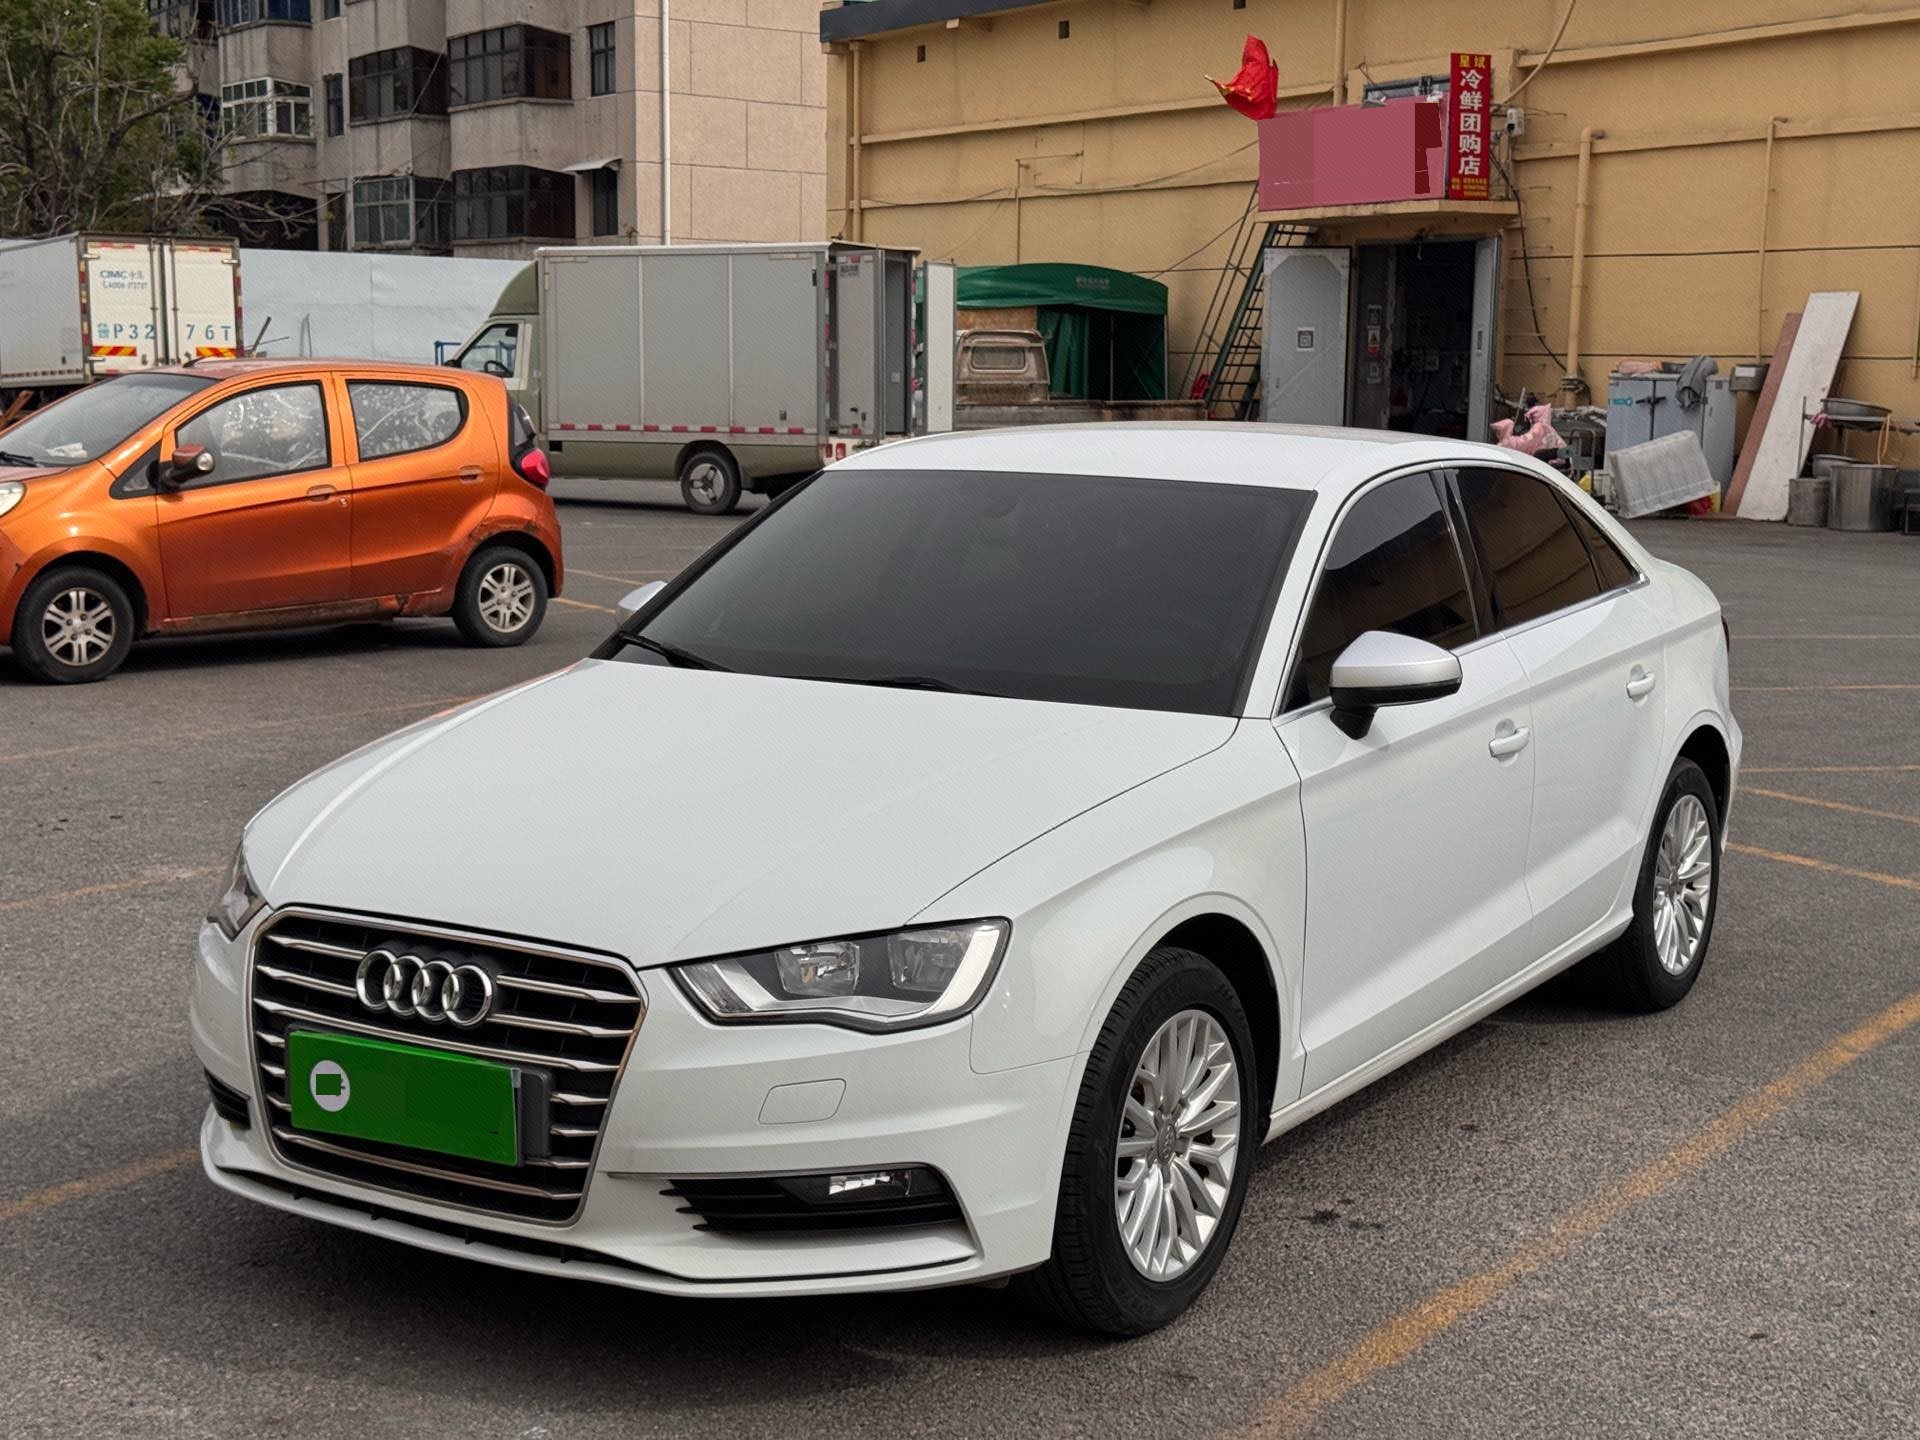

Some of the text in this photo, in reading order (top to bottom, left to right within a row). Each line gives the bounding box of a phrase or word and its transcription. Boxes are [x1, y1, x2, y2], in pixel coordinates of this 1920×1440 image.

[1458, 69, 1483, 175] 冷鲜团购店
